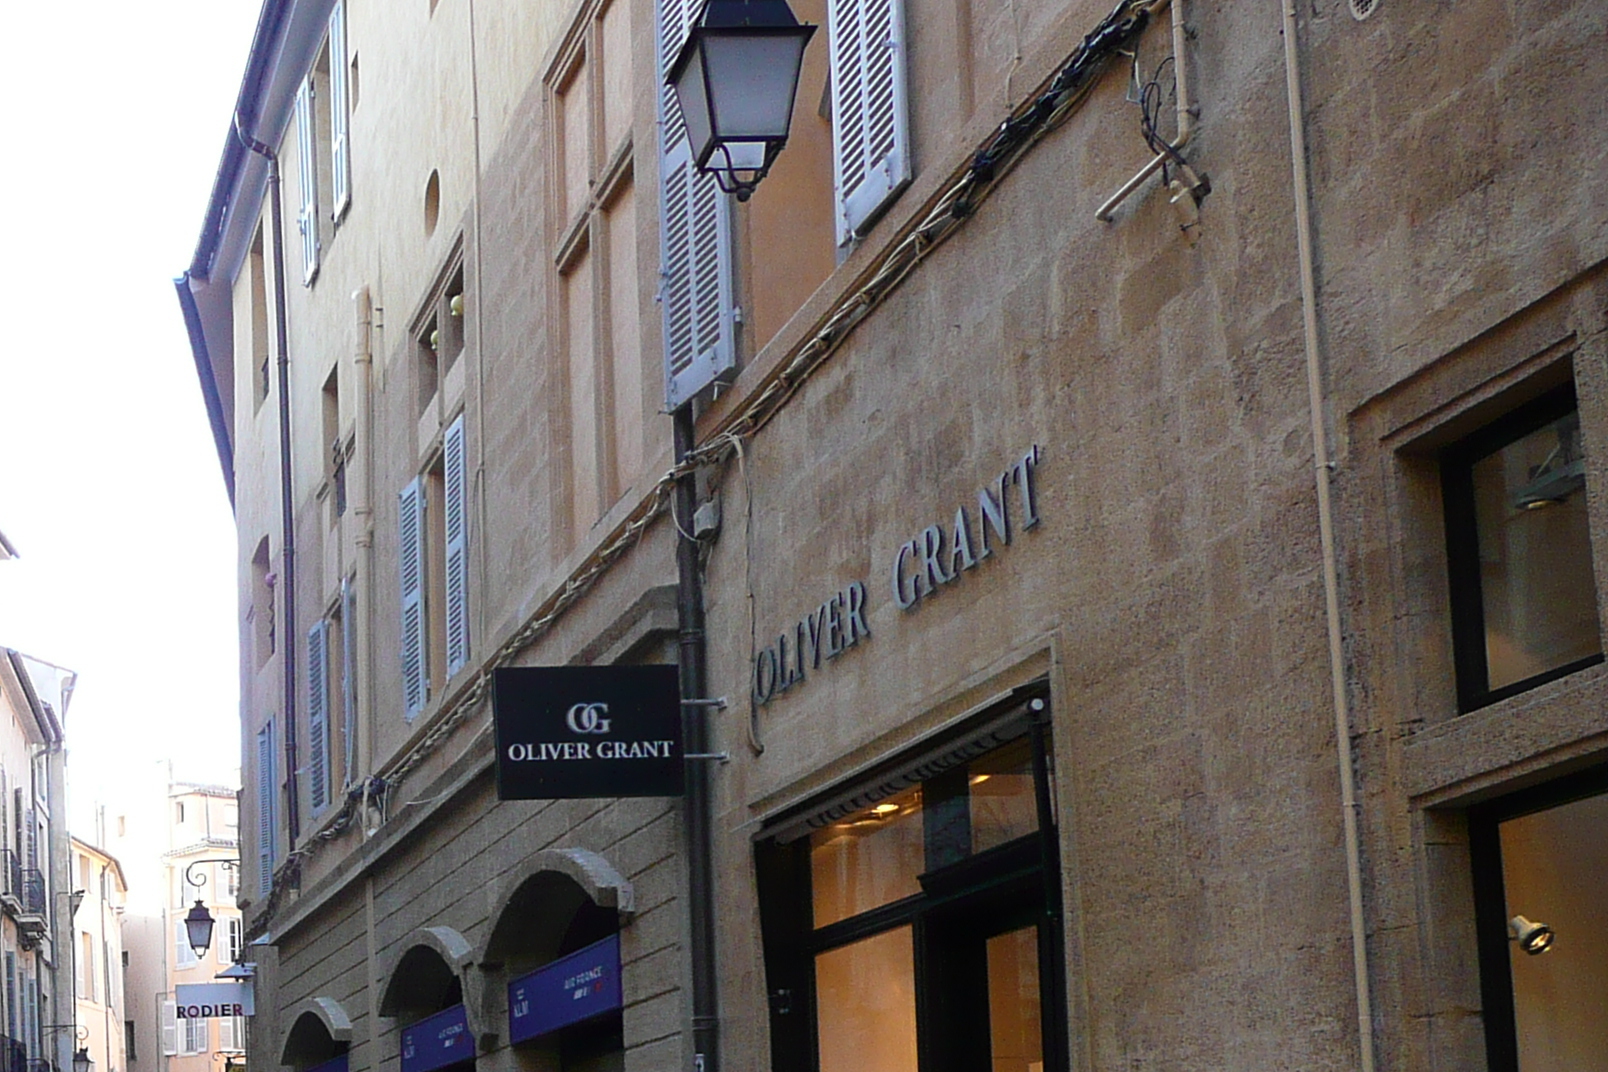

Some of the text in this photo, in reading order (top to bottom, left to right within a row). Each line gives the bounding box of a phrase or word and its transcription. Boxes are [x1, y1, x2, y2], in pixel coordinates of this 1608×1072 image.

[753, 445, 1041, 706] OLIVER GRANT
[508, 741, 674, 761] OLIVER GRANT
[177, 1003, 244, 1019] RODIER
